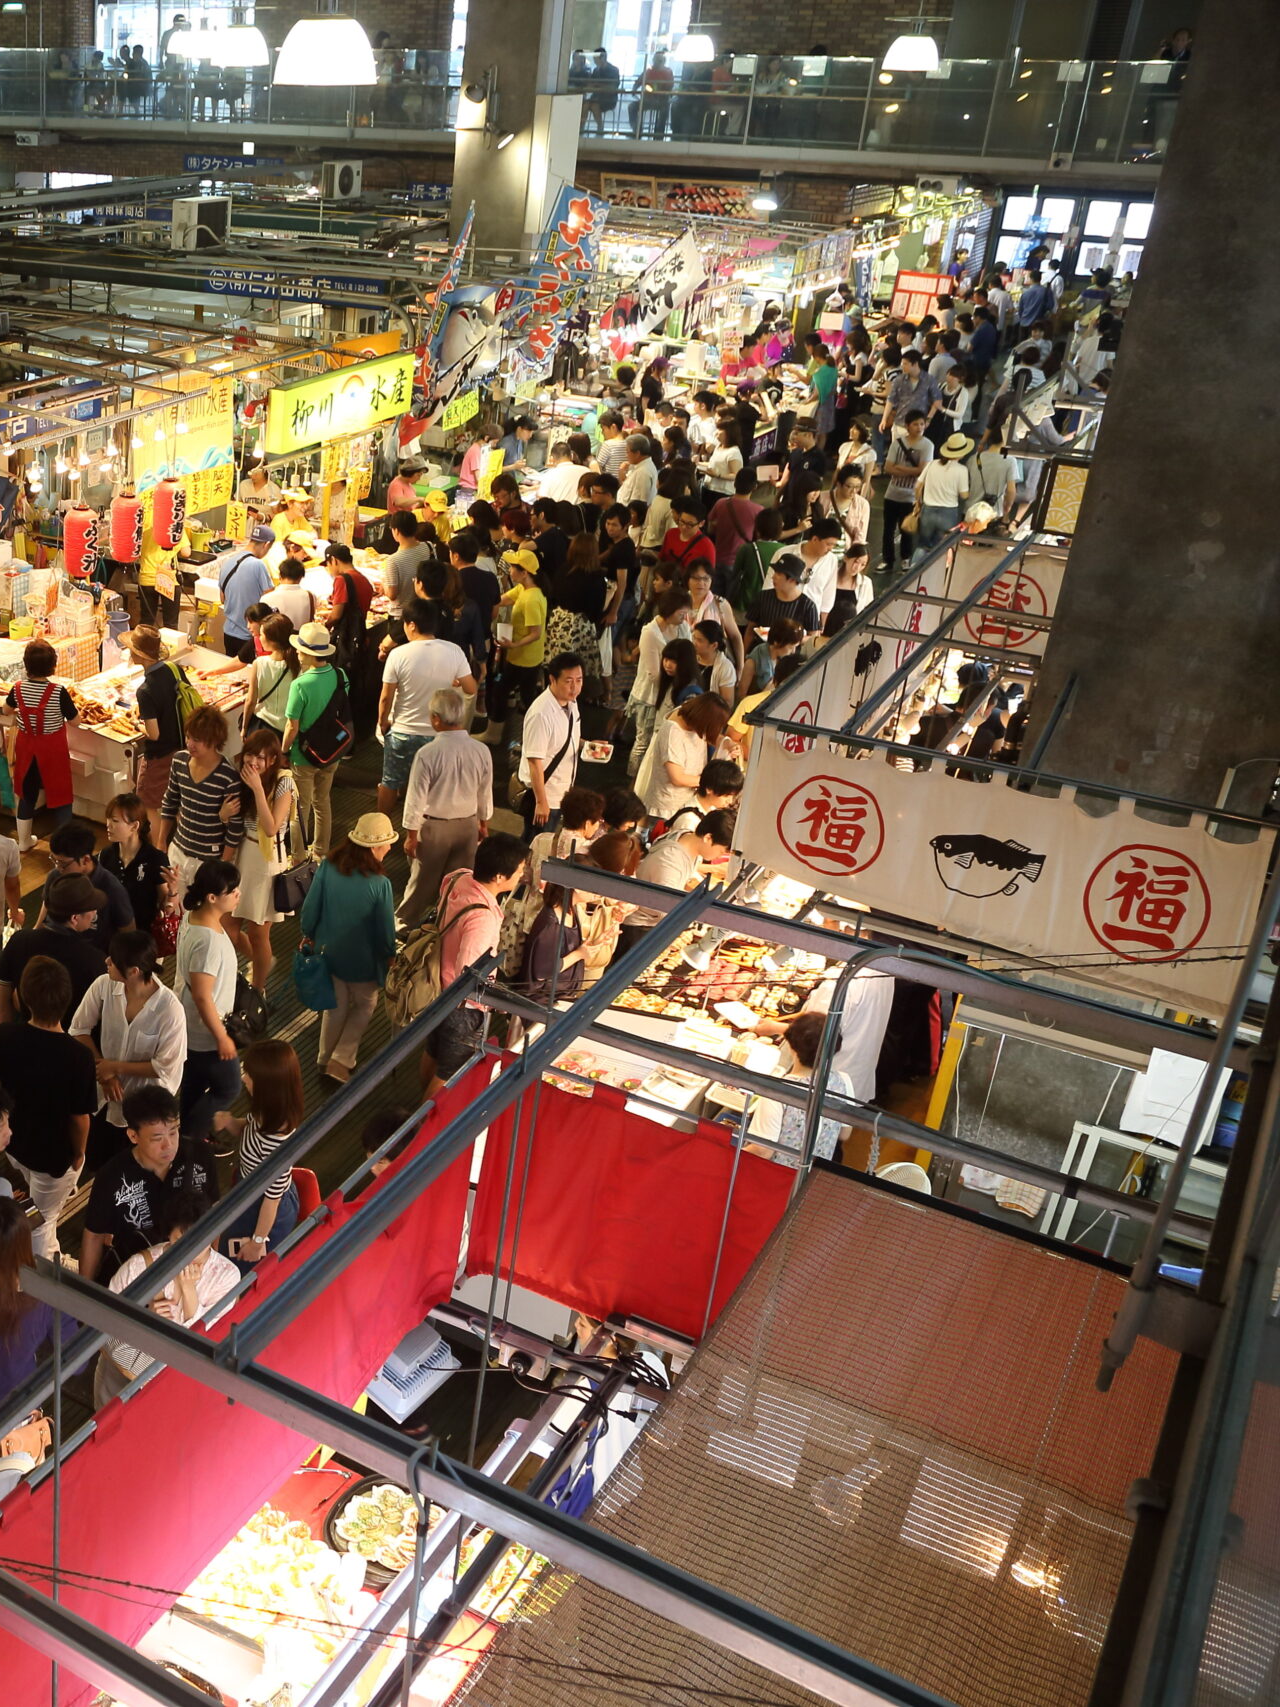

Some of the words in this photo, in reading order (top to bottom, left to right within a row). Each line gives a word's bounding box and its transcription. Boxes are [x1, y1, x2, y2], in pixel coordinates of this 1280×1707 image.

[291, 391, 334, 437] 柳川
[370, 367, 407, 412] 水産
[82, 518, 99, 573] ふく汁
[794, 783, 869, 869] 福一
[1101, 854, 1193, 952] 福一
